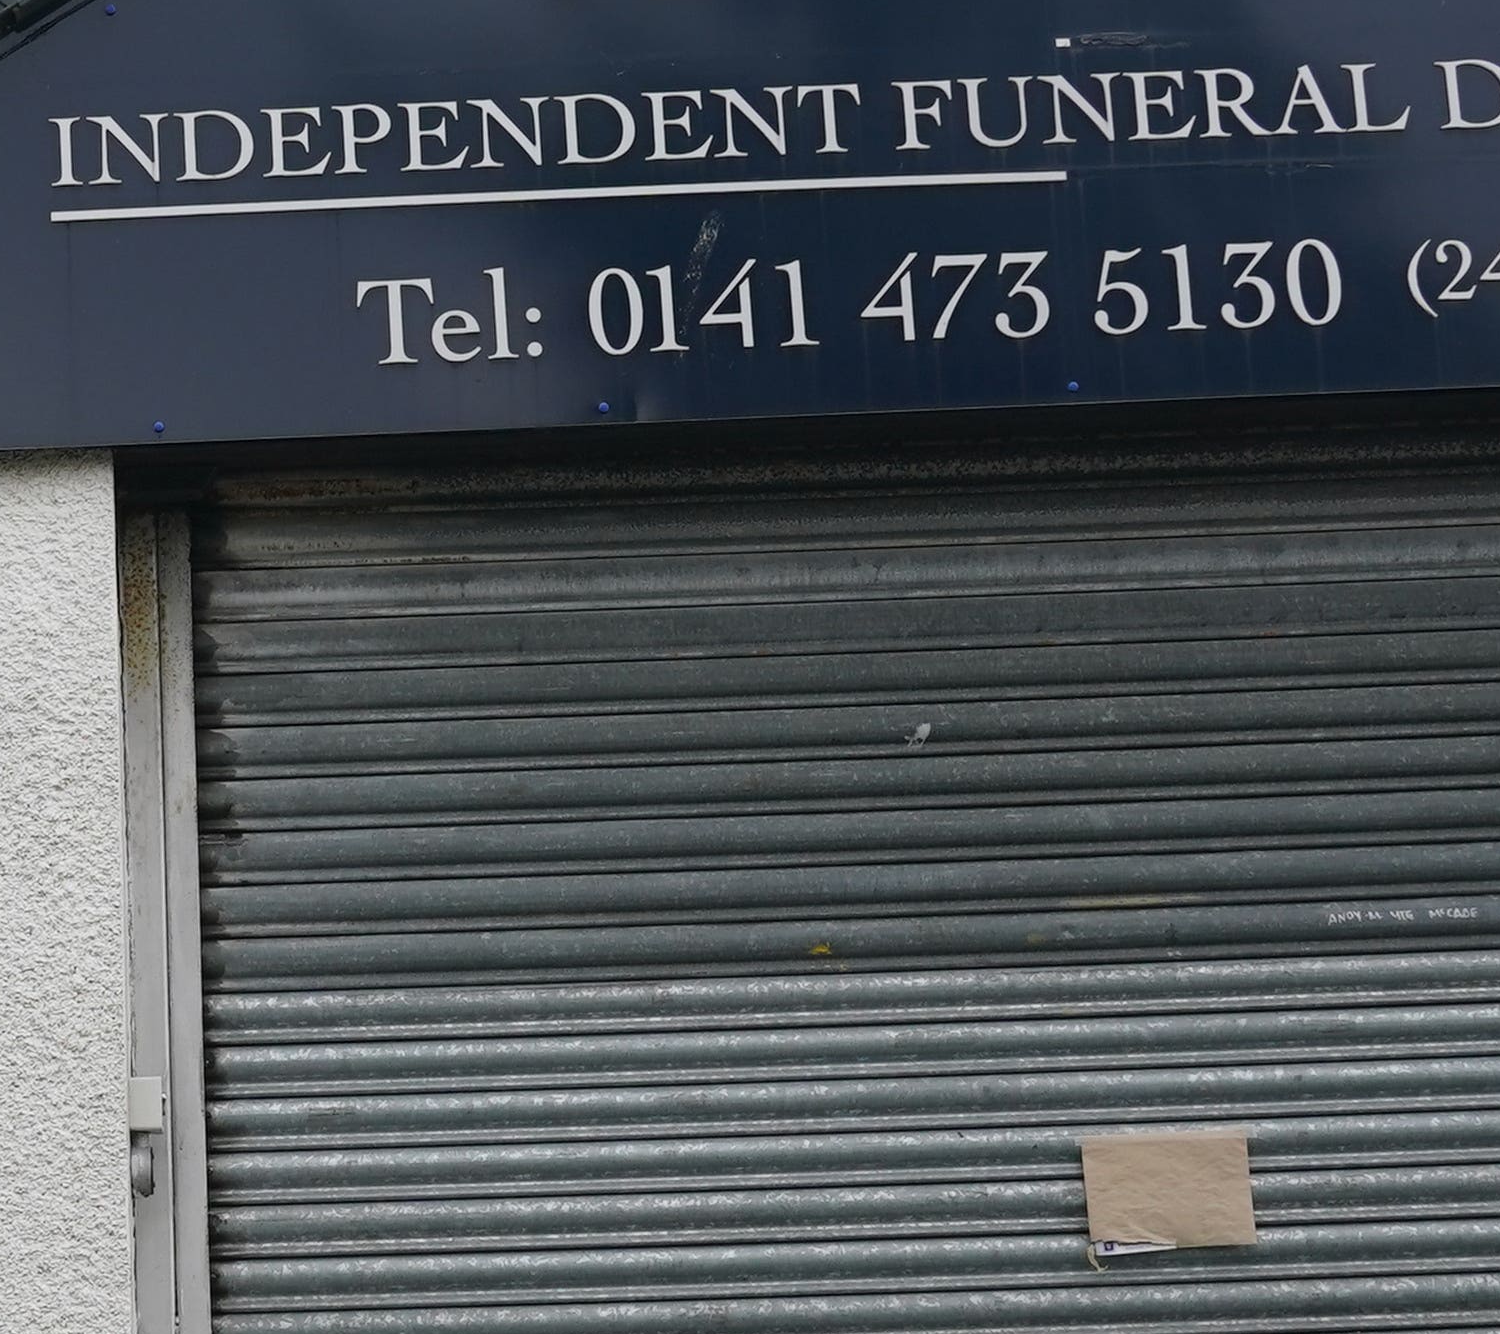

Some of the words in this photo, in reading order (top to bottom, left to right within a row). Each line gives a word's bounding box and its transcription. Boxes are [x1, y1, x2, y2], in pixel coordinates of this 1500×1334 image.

[48, 82, 862, 188] INDEPENDENT
[890, 64, 1410, 151] FUNERAL
[357, 268, 542, 364] Tel:
[589, 259, 819, 355] 0141
[861, 251, 1049, 340] 473
[1095, 239, 1341, 334] 5130
